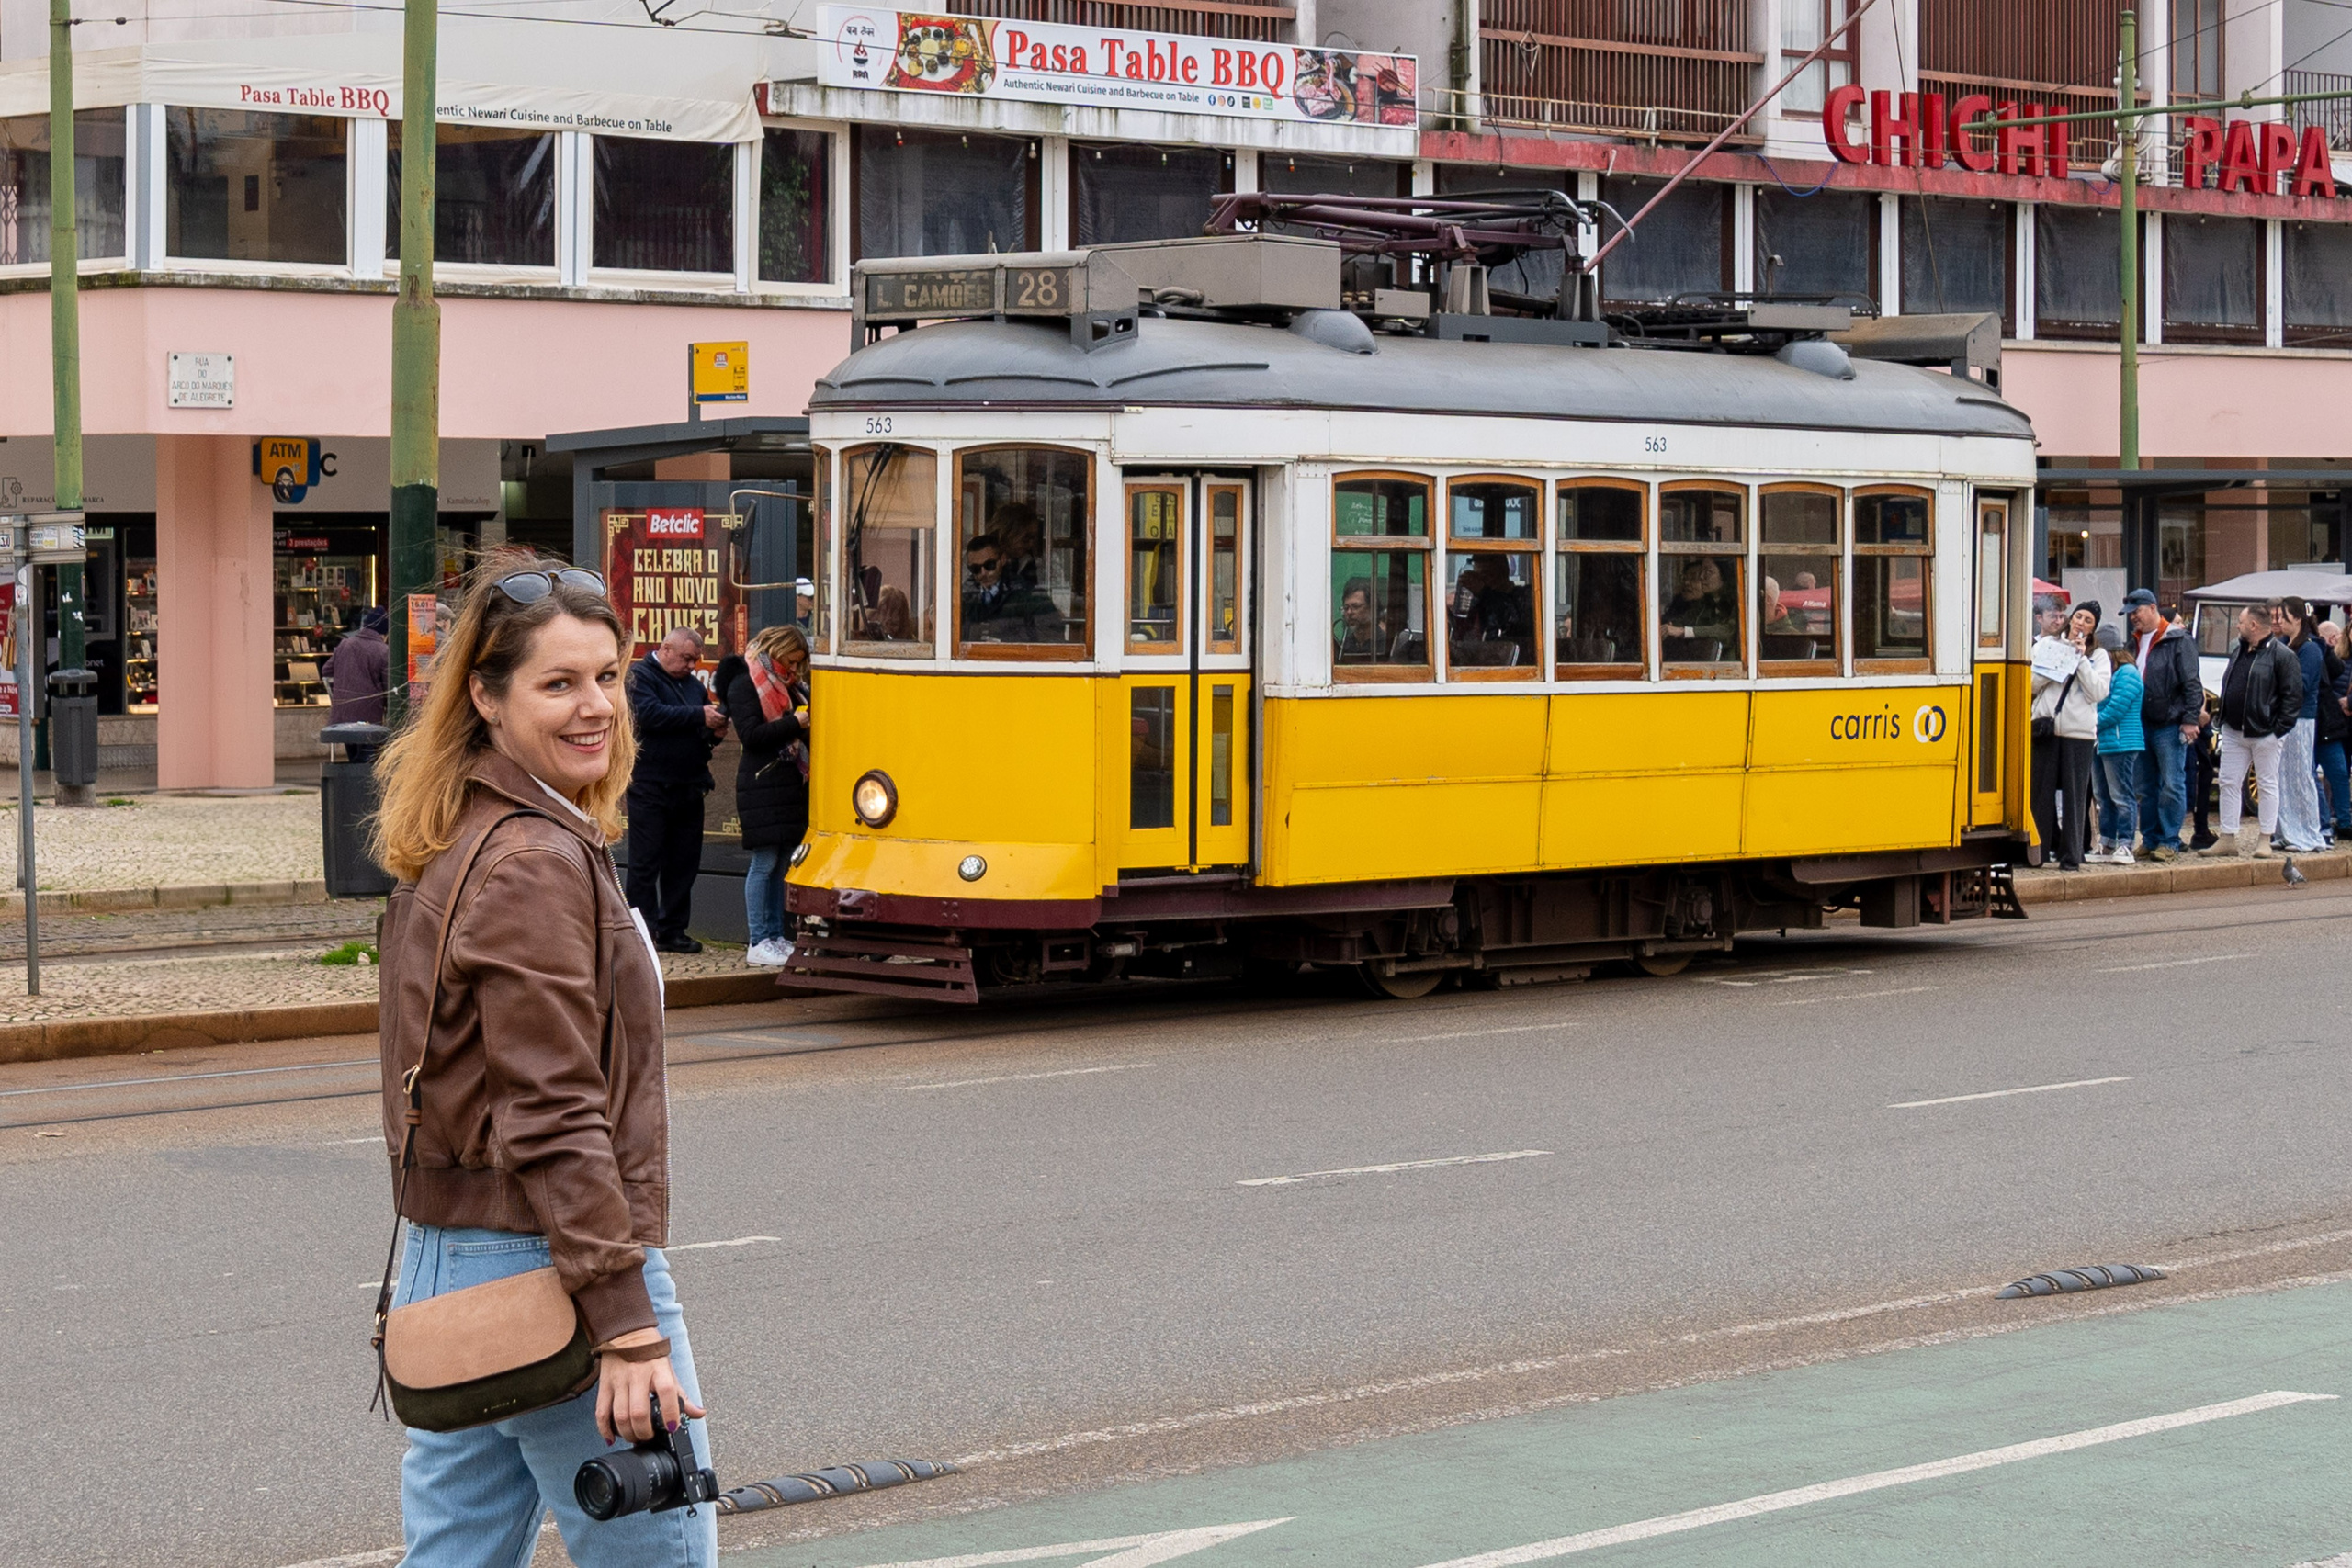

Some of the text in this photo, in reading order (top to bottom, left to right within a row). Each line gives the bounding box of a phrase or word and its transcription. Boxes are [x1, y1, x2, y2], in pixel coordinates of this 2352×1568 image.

[1006, 30, 1284, 99] Pasa Table BBQ
[240, 85, 390, 117] Pasa Table BBQ
[1003, 78, 1044, 91] Authentic
[1046, 82, 1075, 92] Newari
[1077, 84, 1107, 96] Cuisine
[1108, 87, 1125, 96] and
[1126, 88, 1164, 100] Barbecue
[1178, 92, 1199, 102] Table
[436, 105, 673, 133] entic Newari Cuisine and Barbecue on Table
[1823, 84, 2336, 198] CHICHI PAPA
[876, 284, 893, 308] L.
[1017, 271, 1057, 306] 28
[865, 416, 892, 434] 563
[269, 443, 301, 458] ATM
[1645, 436, 1667, 452] 563
[650, 513, 700, 534] Betclic
[633, 548, 718, 576] CELEBRA O
[632, 576, 718, 604] ANO NOVO
[1830, 703, 1901, 740] carris
